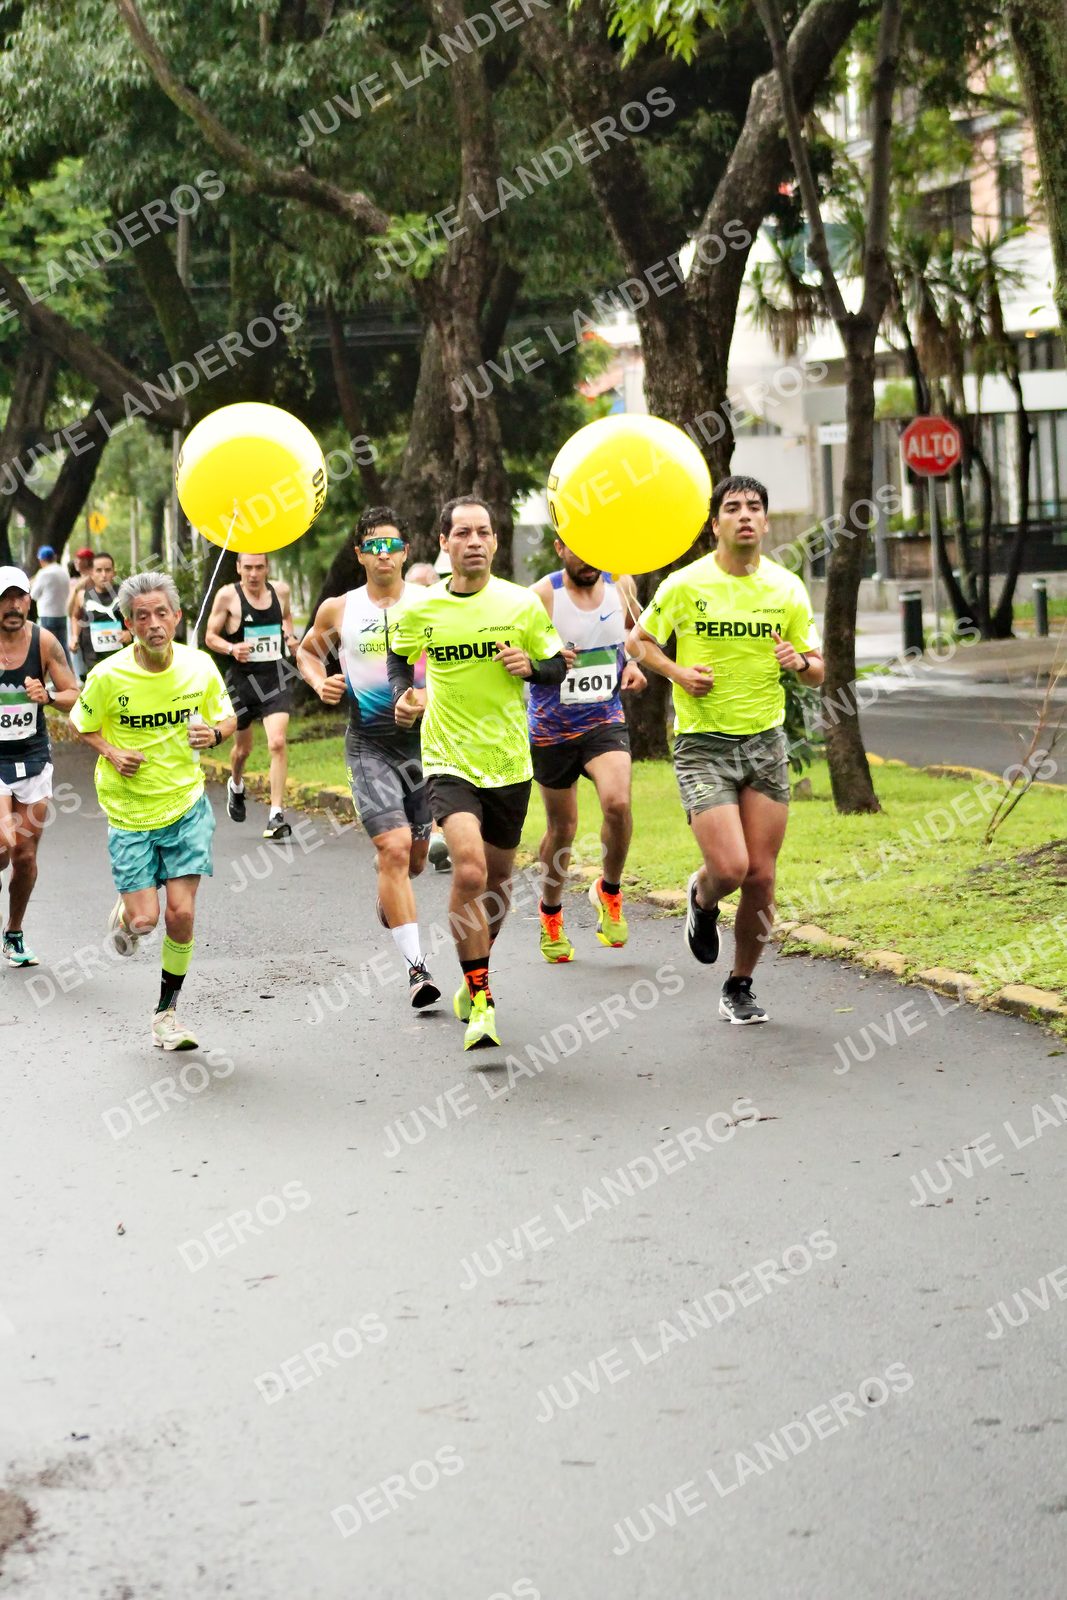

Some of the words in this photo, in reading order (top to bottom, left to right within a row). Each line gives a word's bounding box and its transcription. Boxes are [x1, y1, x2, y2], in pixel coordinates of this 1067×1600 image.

[908, 432, 955, 458] ALTO
[567, 674, 612, 693] 1601
[0, 712, 34, 729] 849
